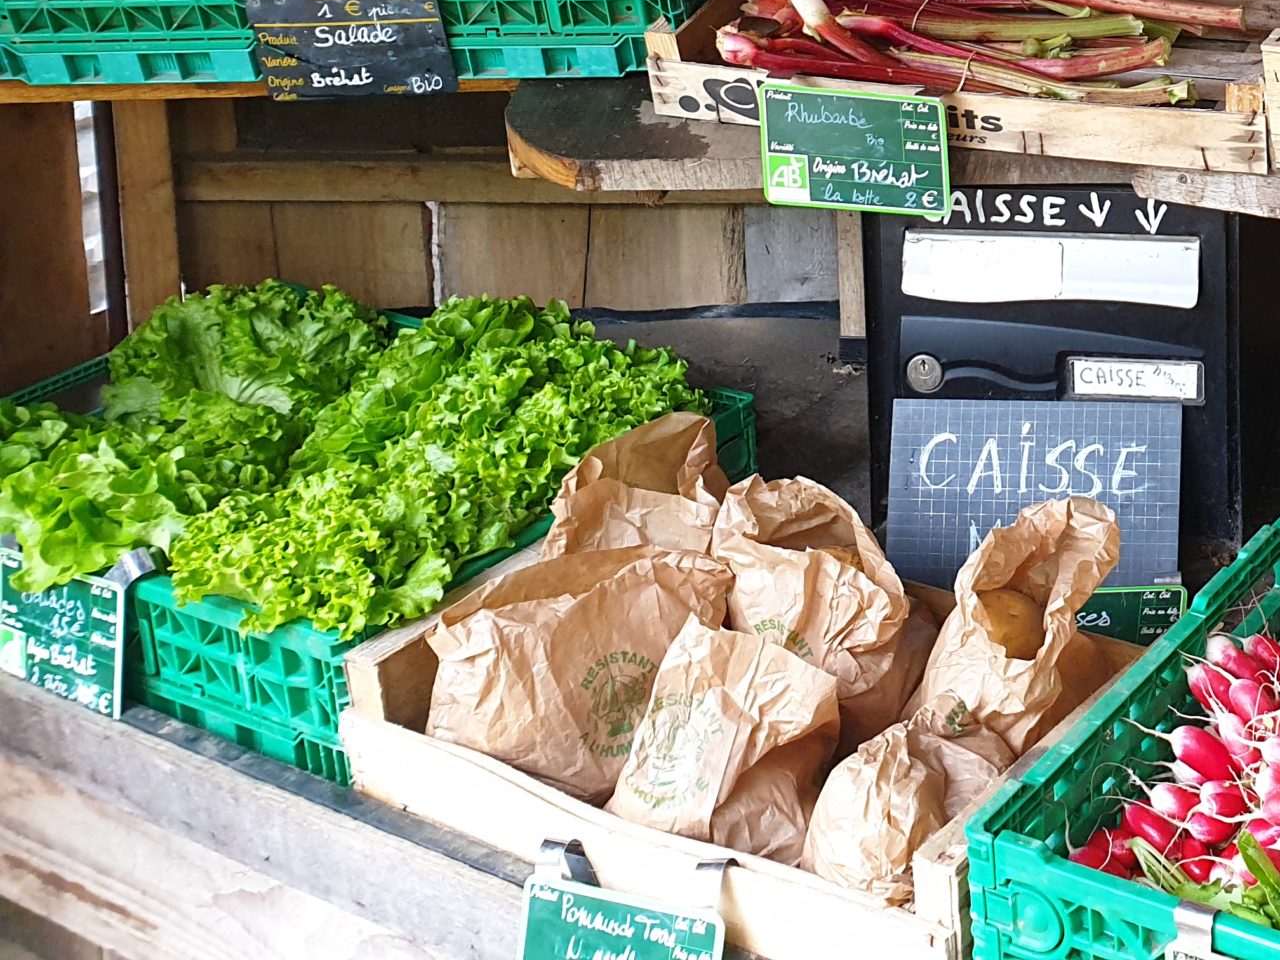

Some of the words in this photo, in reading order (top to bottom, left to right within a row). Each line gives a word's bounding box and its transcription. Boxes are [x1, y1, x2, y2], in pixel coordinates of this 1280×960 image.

[317, 3, 333, 18] 1
[344, 0, 362, 16] €
[314, 24, 397, 47] Salade
[268, 75, 304, 91] Origine
[771, 164, 803, 187] AB
[812, 156, 846, 179] Origine
[824, 183, 844, 202] la
[921, 190, 938, 208] €
[924, 189, 1066, 227] AISSE
